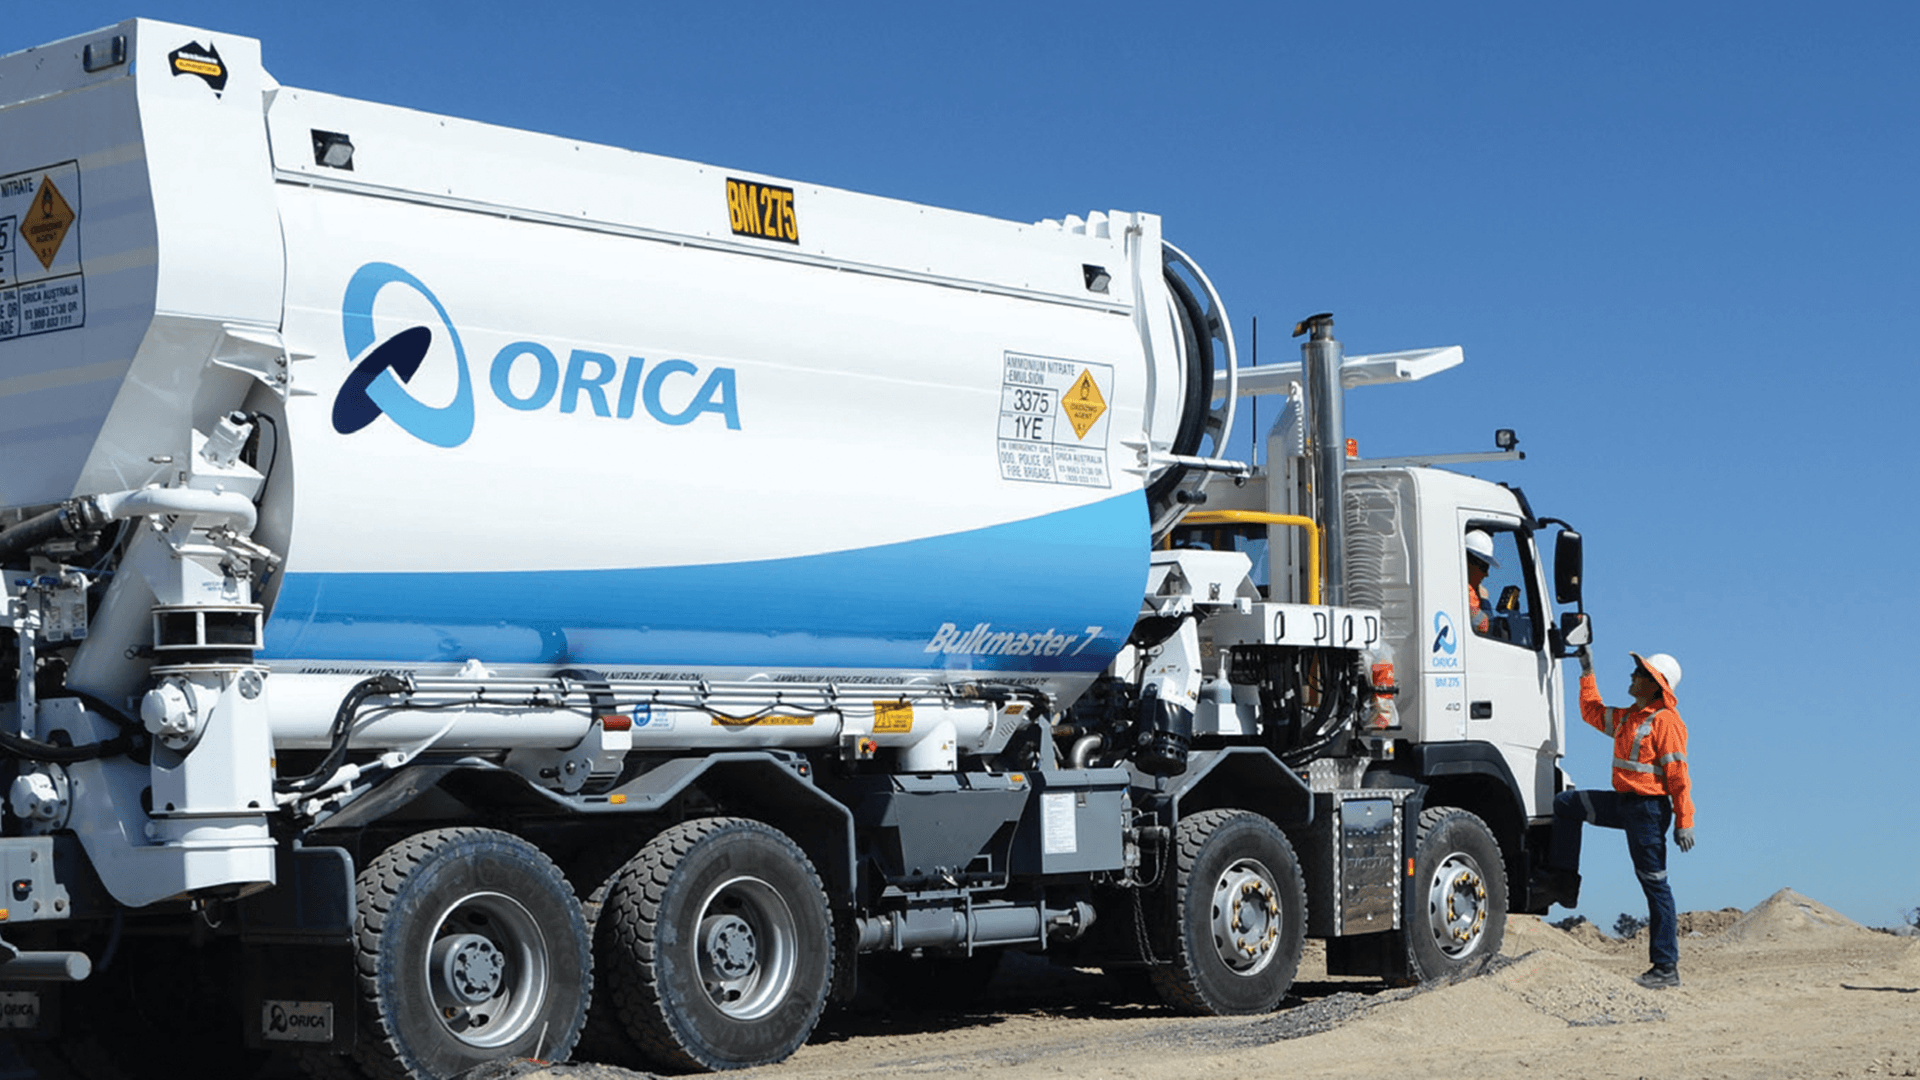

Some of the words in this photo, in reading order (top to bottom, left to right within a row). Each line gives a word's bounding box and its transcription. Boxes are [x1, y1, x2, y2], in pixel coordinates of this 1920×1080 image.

[0, 177, 34, 198] NITRATE
[728, 180, 761, 234] BM
[760, 187, 798, 241] 275
[22, 291, 41, 304] ORICA
[43, 283, 78, 299] AUSTRALIA
[1006, 356, 1046, 372] AMMONIUM
[1047, 361, 1075, 377] NITRATE
[489, 340, 742, 431] ORICA
[1014, 389, 1049, 413] 3375
[1015, 415, 1043, 440] 1YE
[924, 622, 1079, 657] Bulkmaster
[1070, 625, 1103, 658] 7
[1433, 657, 1458, 667] ORICA
[609, 671, 651, 681] NITRATE
[4, 1003, 34, 1016] ORICA
[289, 1014, 325, 1028] ORICA
